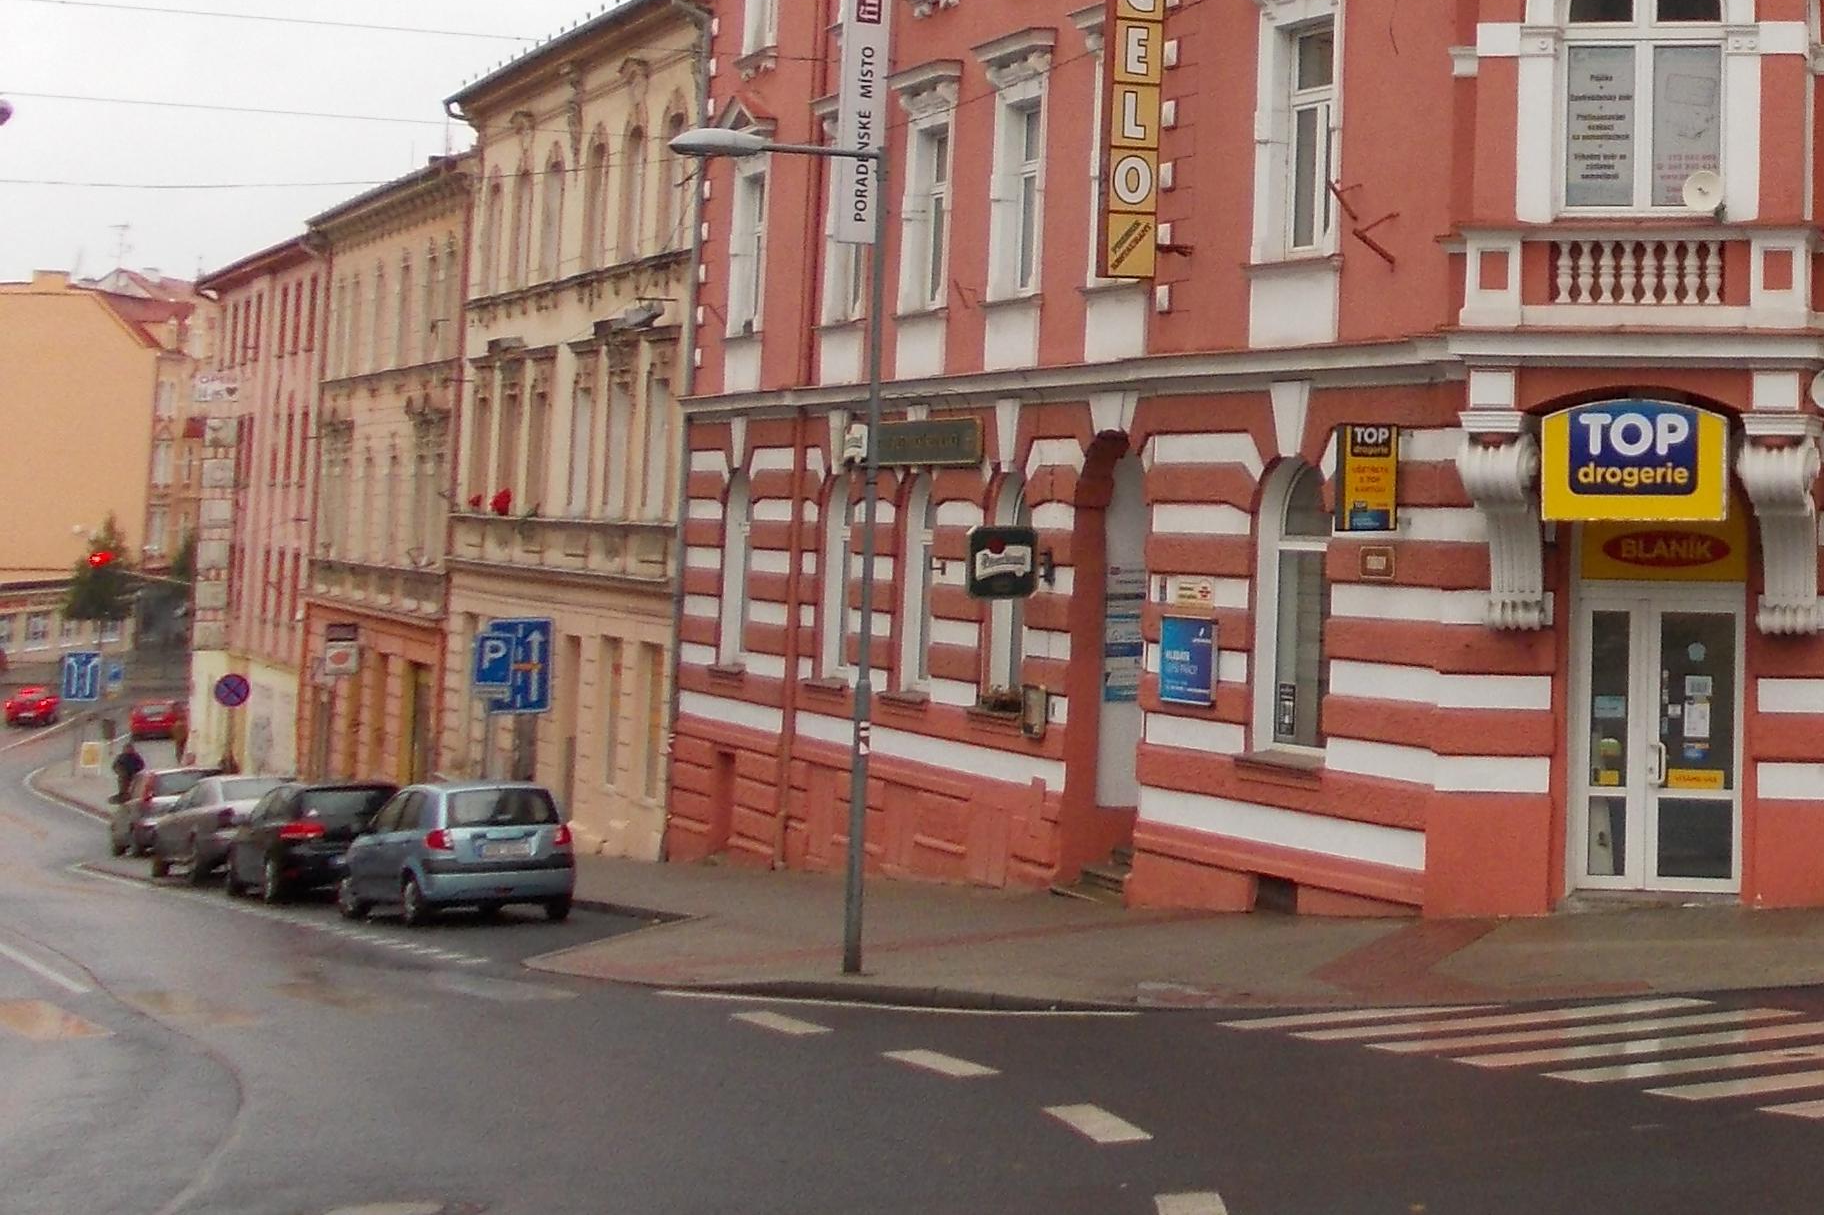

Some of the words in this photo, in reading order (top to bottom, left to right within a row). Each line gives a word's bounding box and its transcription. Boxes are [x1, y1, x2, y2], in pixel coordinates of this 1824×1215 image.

[857, 46, 875, 98] MÍSTO
[1354, 427, 1389, 444] TOP
[1579, 413, 1689, 456] TOP
[1578, 462, 1689, 488] drogerie
[1620, 537, 1713, 559] BLANÍK
[482, 639, 507, 670] P
